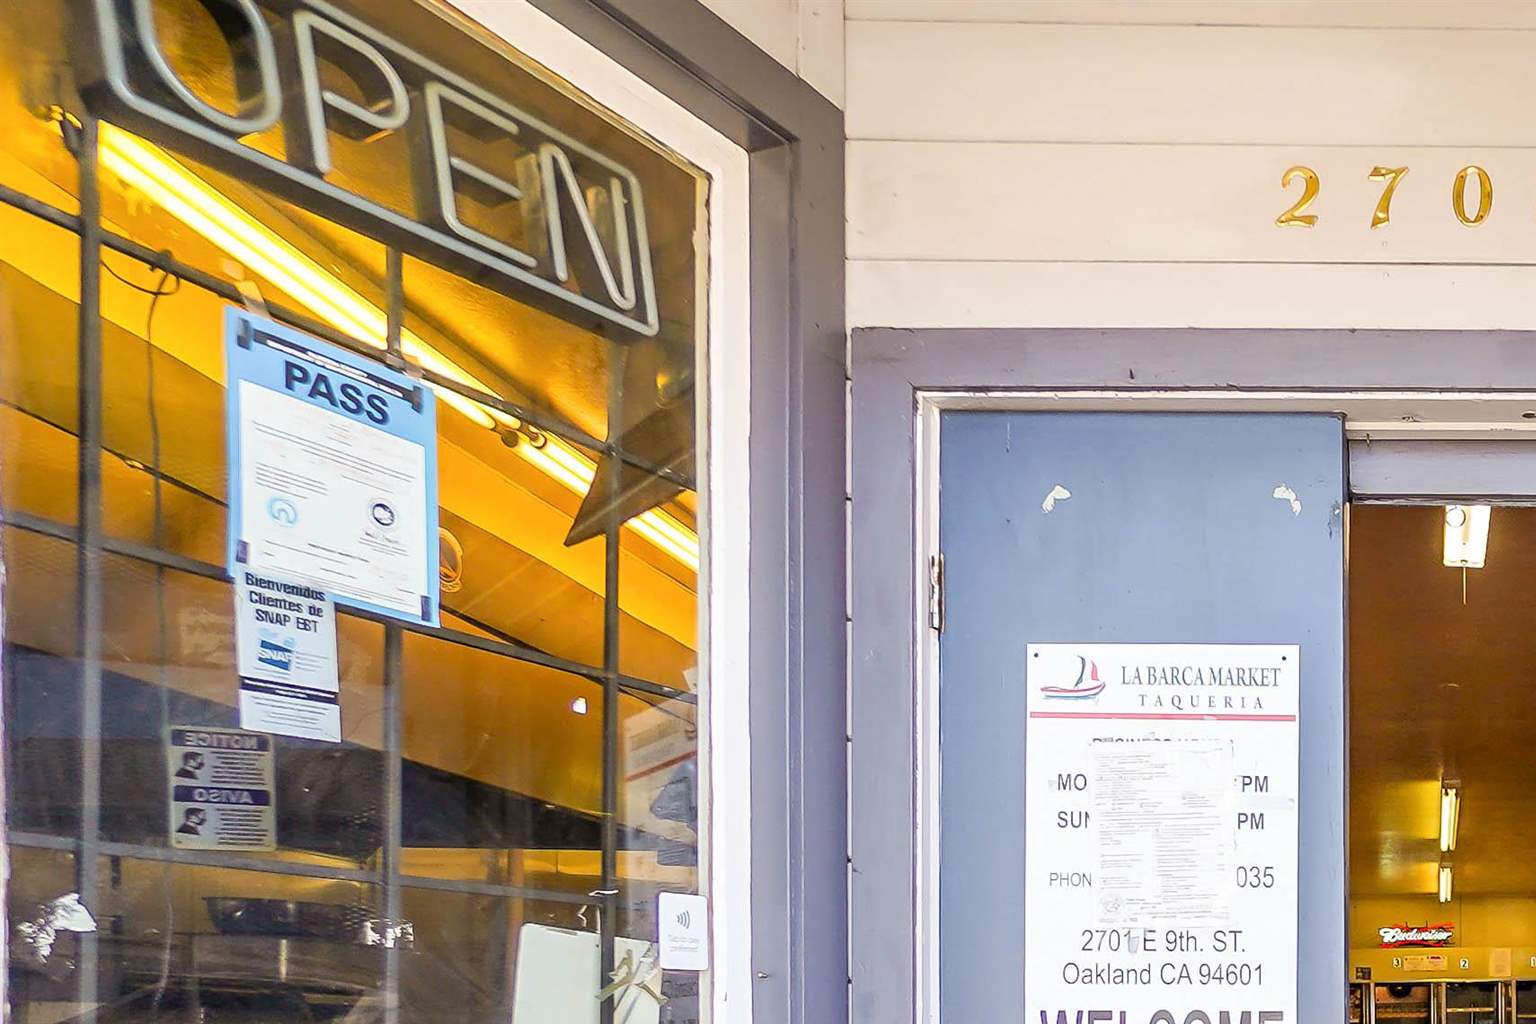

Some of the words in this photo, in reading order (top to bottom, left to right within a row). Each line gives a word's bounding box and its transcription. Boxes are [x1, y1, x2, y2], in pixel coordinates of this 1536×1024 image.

[136, 0, 636, 311] OPEN
[284, 360, 390, 426] PASS
[245, 572, 326, 601] Bienvenidos
[249, 591, 304, 614] Clientes
[308, 603, 324, 618] de
[255, 608, 291, 628] SNAP
[1121, 666, 1142, 686] LA
[1147, 666, 1204, 687] BARCA
[1208, 667, 1282, 688] MARKET
[1139, 694, 1264, 711] TAQUERIA
[1057, 774, 1088, 792] MO
[1241, 775, 1269, 793] PM
[1237, 812, 1265, 830] PM
[1049, 872, 1093, 887] PHON
[1236, 866, 1275, 888] 035
[1081, 929, 1133, 952] 2701
[1143, 929, 1157, 952] E
[1166, 930, 1204, 952] 9th.
[1212, 930, 1246, 952] ST.
[1062, 962, 1152, 986] Oakland
[1160, 963, 1193, 986] CA
[1199, 963, 1262, 986] 94601
